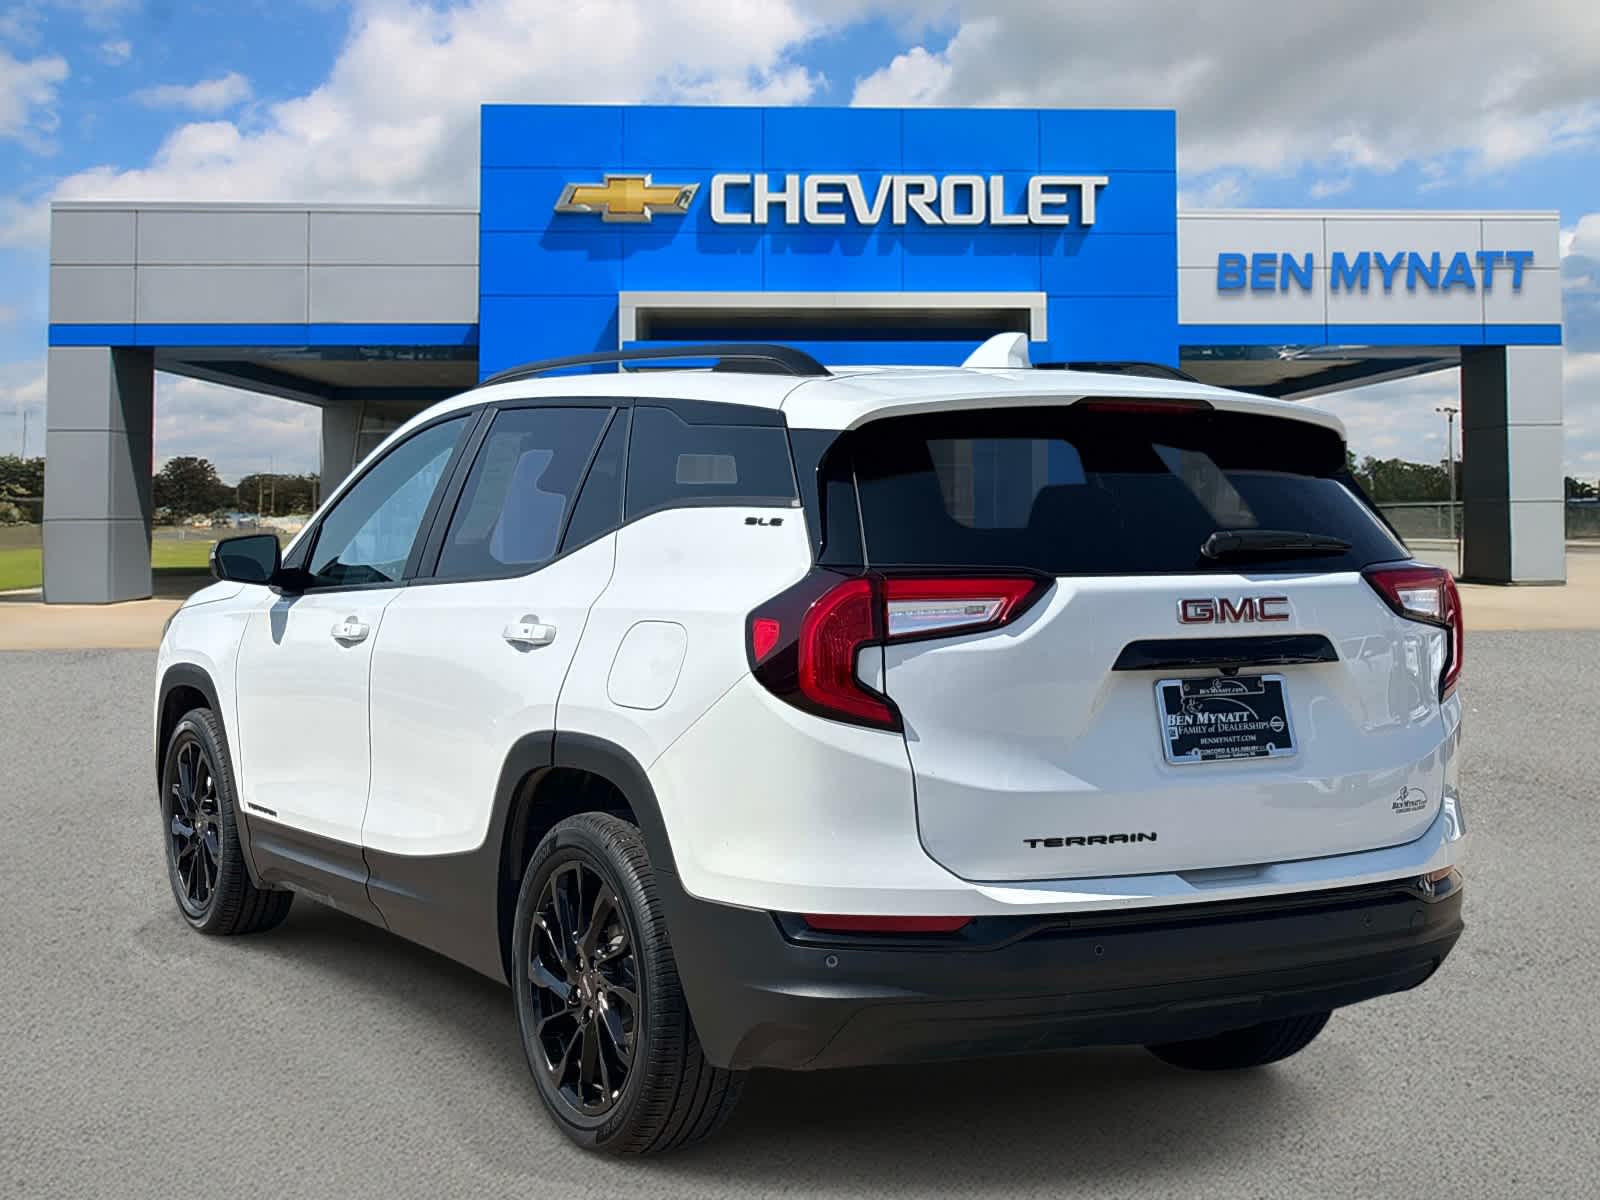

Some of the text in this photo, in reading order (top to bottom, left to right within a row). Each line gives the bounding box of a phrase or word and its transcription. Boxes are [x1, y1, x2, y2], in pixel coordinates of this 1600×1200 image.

[711, 174, 1109, 225] CHEVROLET
[1217, 250, 1534, 290] BEN MYNATT
[744, 516, 784, 526] SLE
[1177, 596, 1290, 624] GMC
[1167, 711, 1250, 726] BEN MYNATT
[1178, 724, 1207, 735] FAMILY
[1217, 721, 1270, 732] DEALERSHIPS
[1023, 832, 1157, 848] TERRAIN
